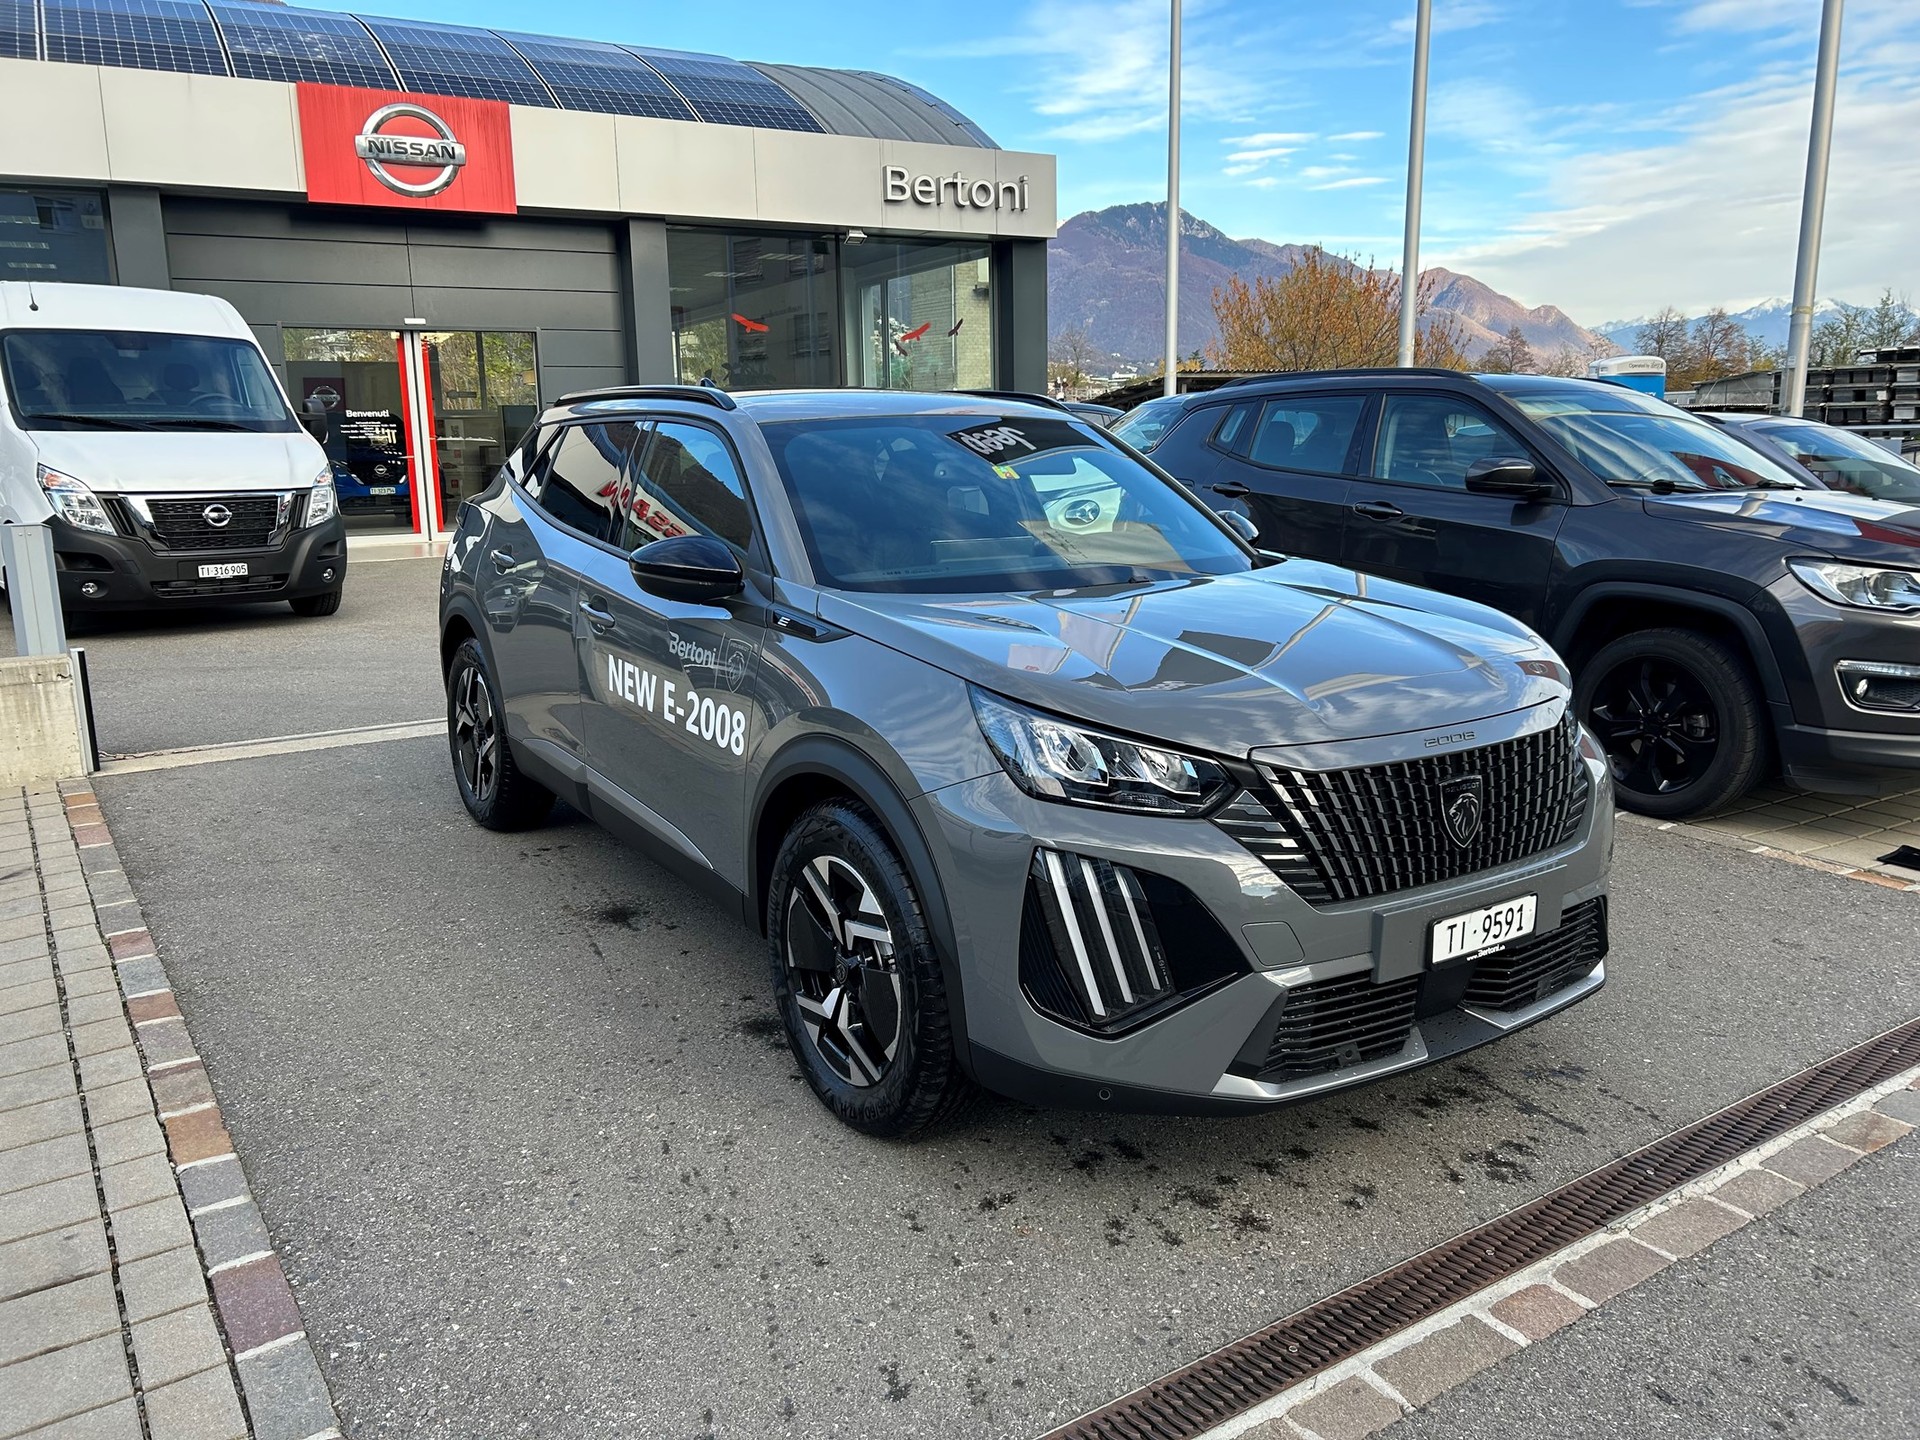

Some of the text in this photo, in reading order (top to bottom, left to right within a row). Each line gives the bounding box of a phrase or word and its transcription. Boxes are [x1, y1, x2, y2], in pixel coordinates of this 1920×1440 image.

[367, 139, 456, 160] NISSAN
[883, 164, 1029, 211] Bertoni
[958, 427, 1037, 455] Jeep
[669, 631, 716, 668] Bertoni
[608, 653, 657, 713] NEW
[663, 679, 747, 757] E-2008
[1424, 731, 1477, 749] 2008
